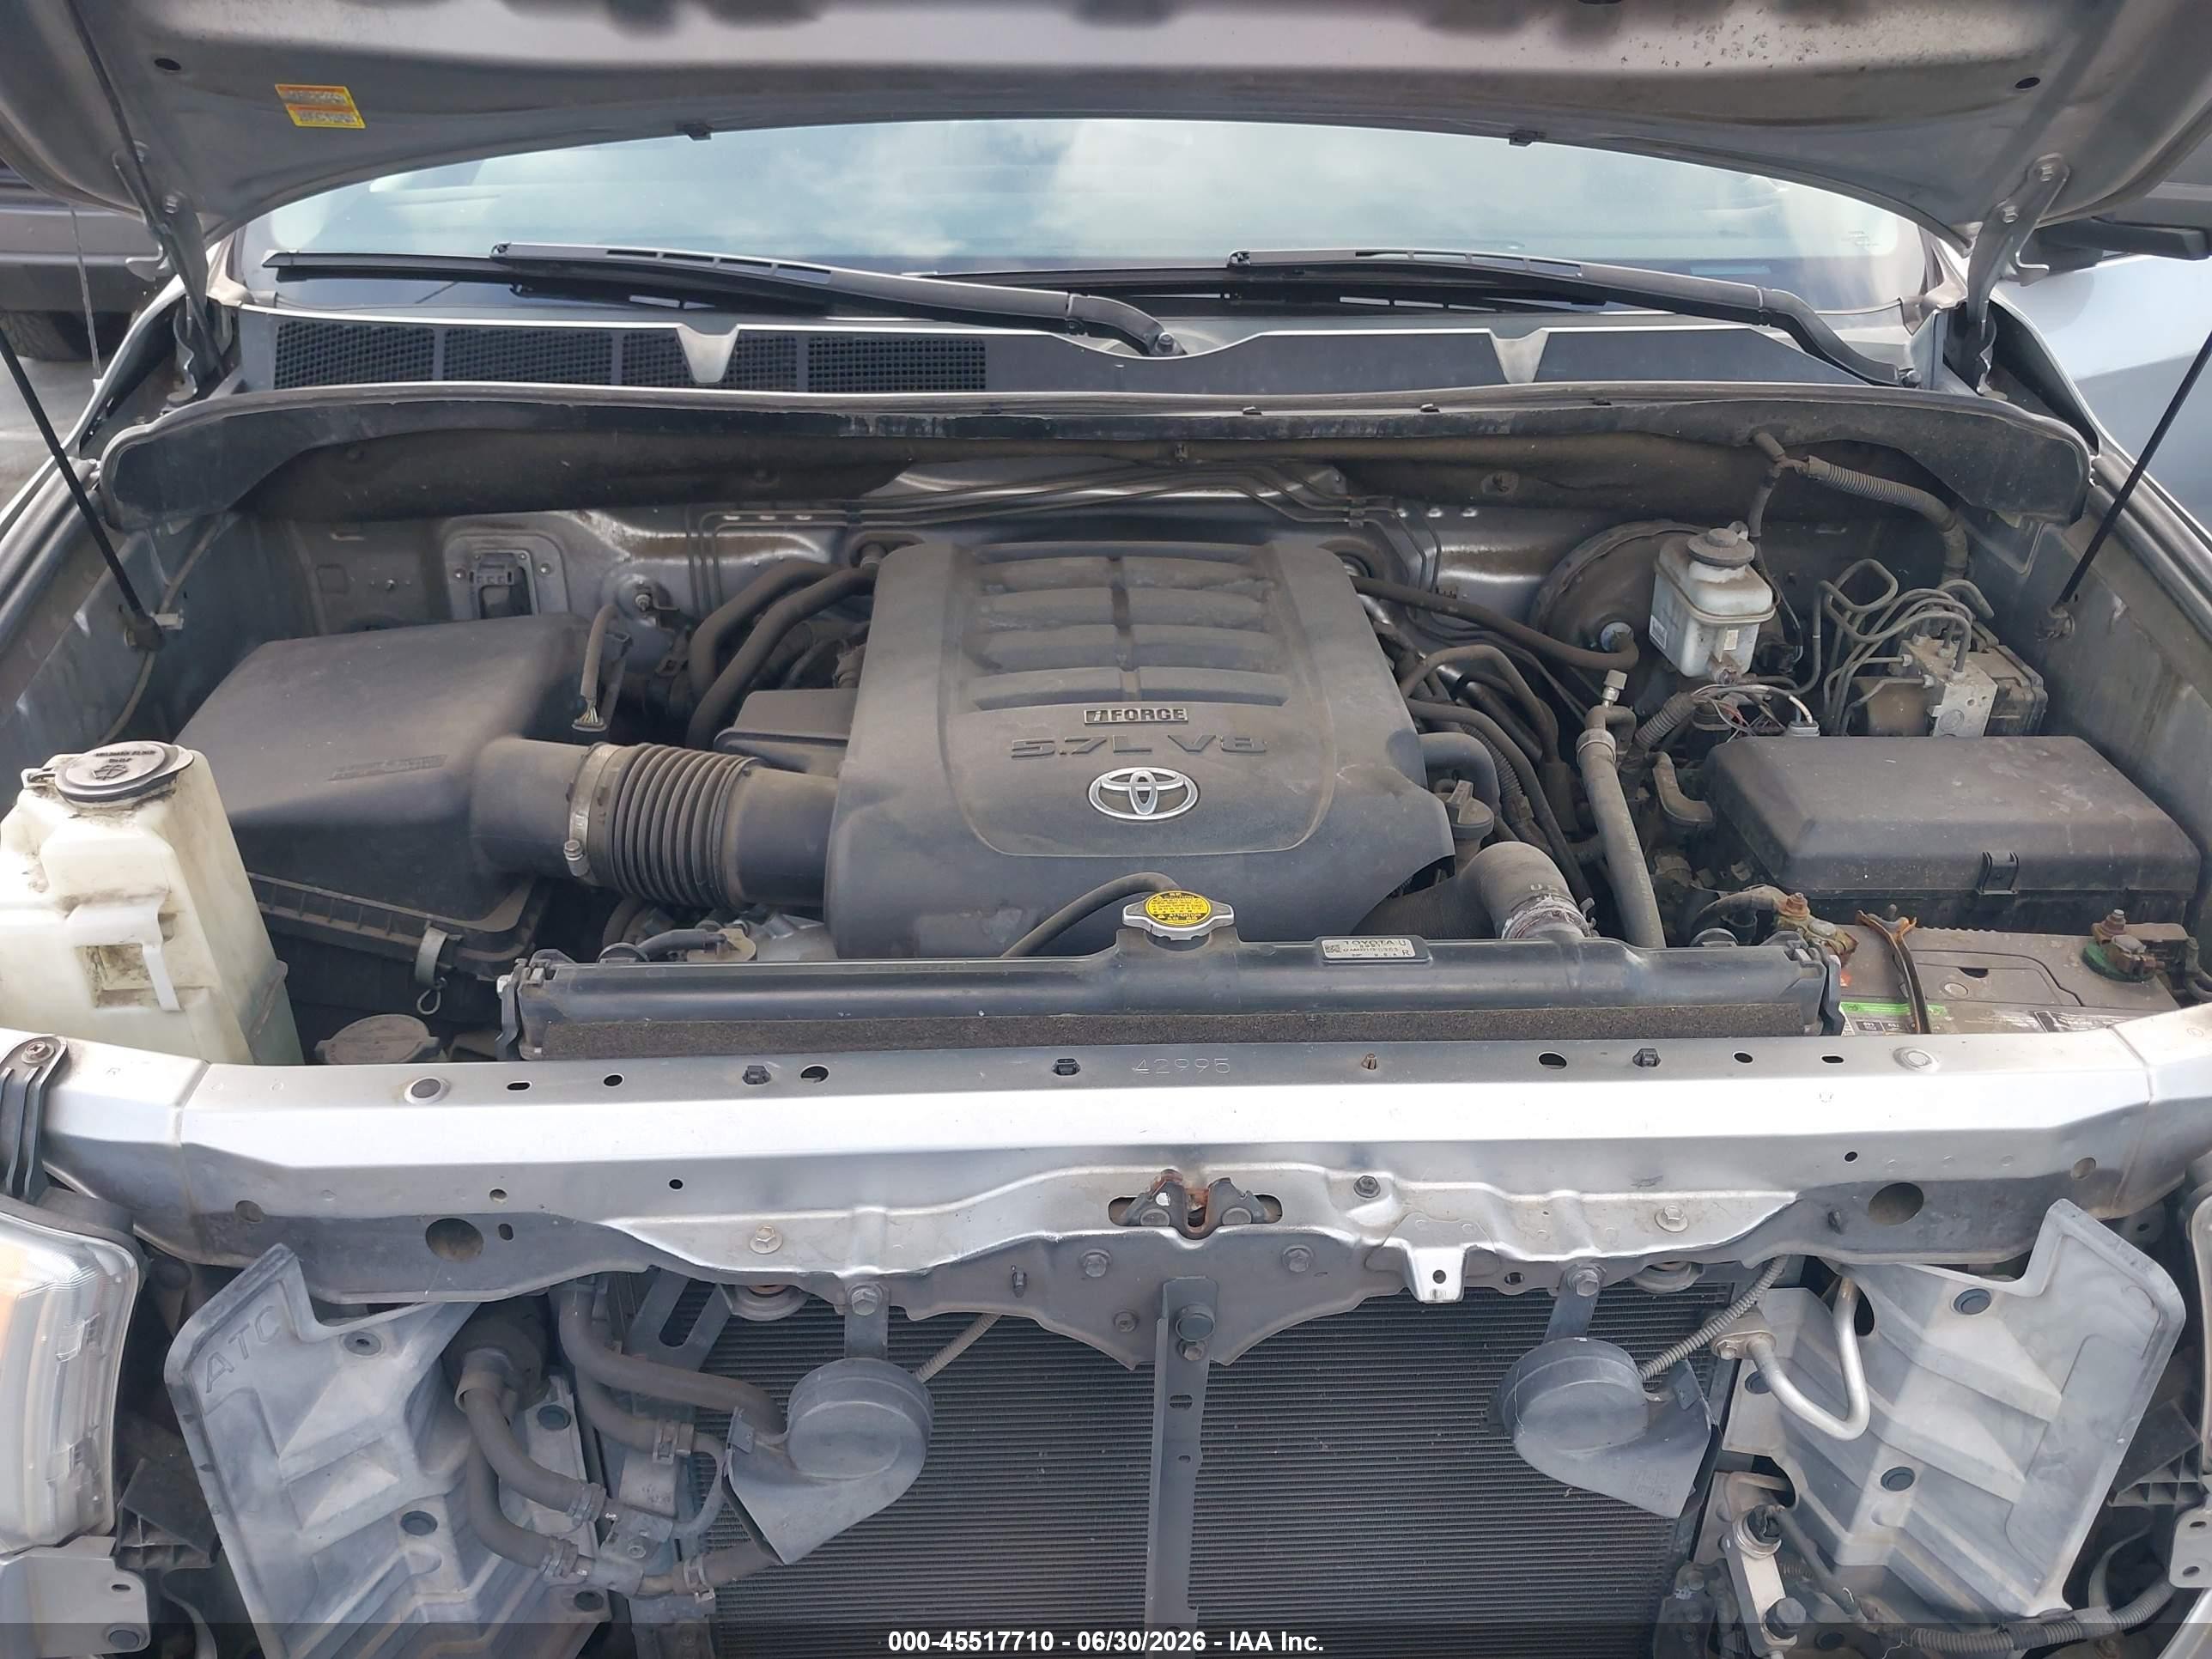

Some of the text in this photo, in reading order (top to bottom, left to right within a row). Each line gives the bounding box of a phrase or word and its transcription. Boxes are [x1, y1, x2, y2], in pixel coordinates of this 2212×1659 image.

[1012, 734, 1267, 758] 5.7L V8
[1132, 1057, 1231, 1074] 42995
